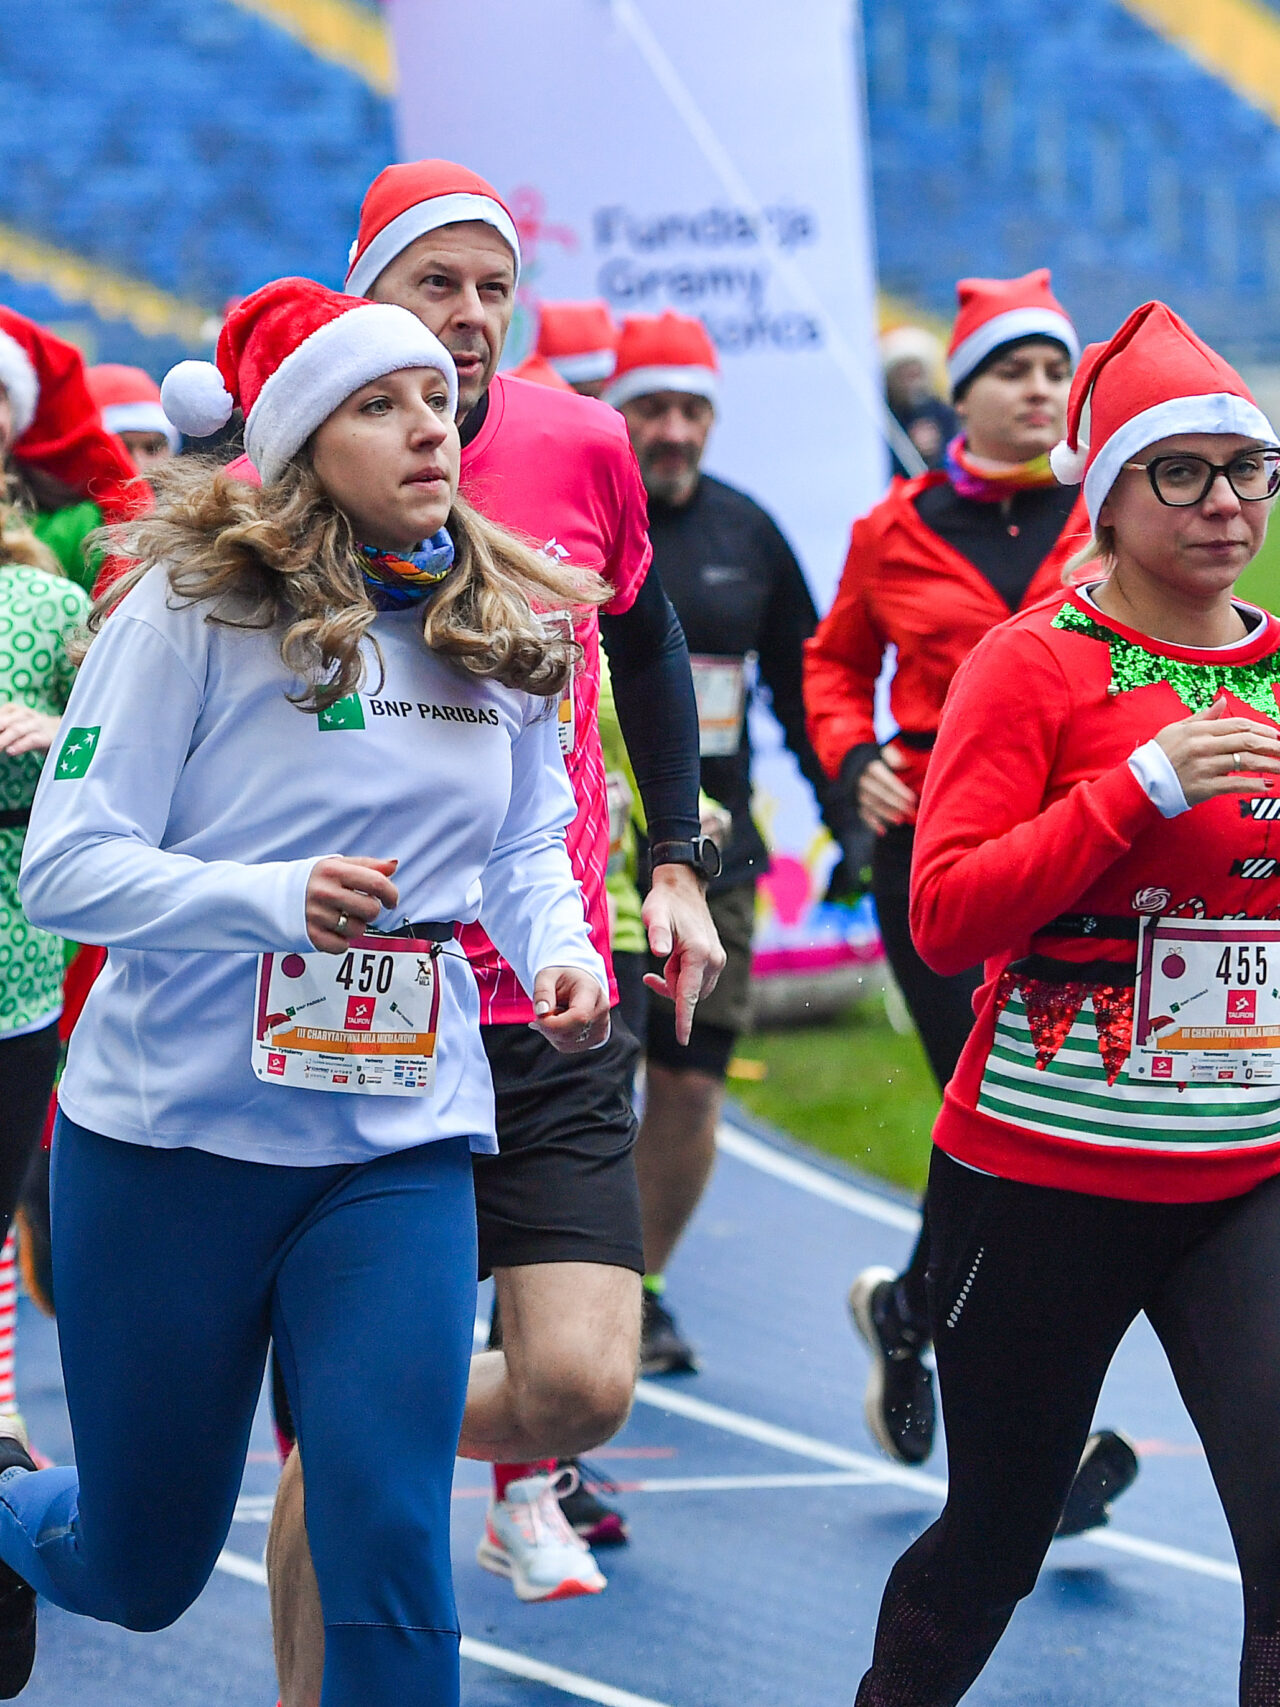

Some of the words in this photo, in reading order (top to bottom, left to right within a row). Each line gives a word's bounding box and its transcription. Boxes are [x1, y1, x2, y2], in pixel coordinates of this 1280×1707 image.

[370, 699, 413, 717] BNP
[417, 703, 499, 726] PARIBAS
[336, 952, 395, 994] 450
[1216, 946, 1267, 985] 455
[346, 1016, 371, 1025] TAURON
[296, 1027, 307, 1038] III
[307, 1029, 360, 1043] CHARYTATYWNA
